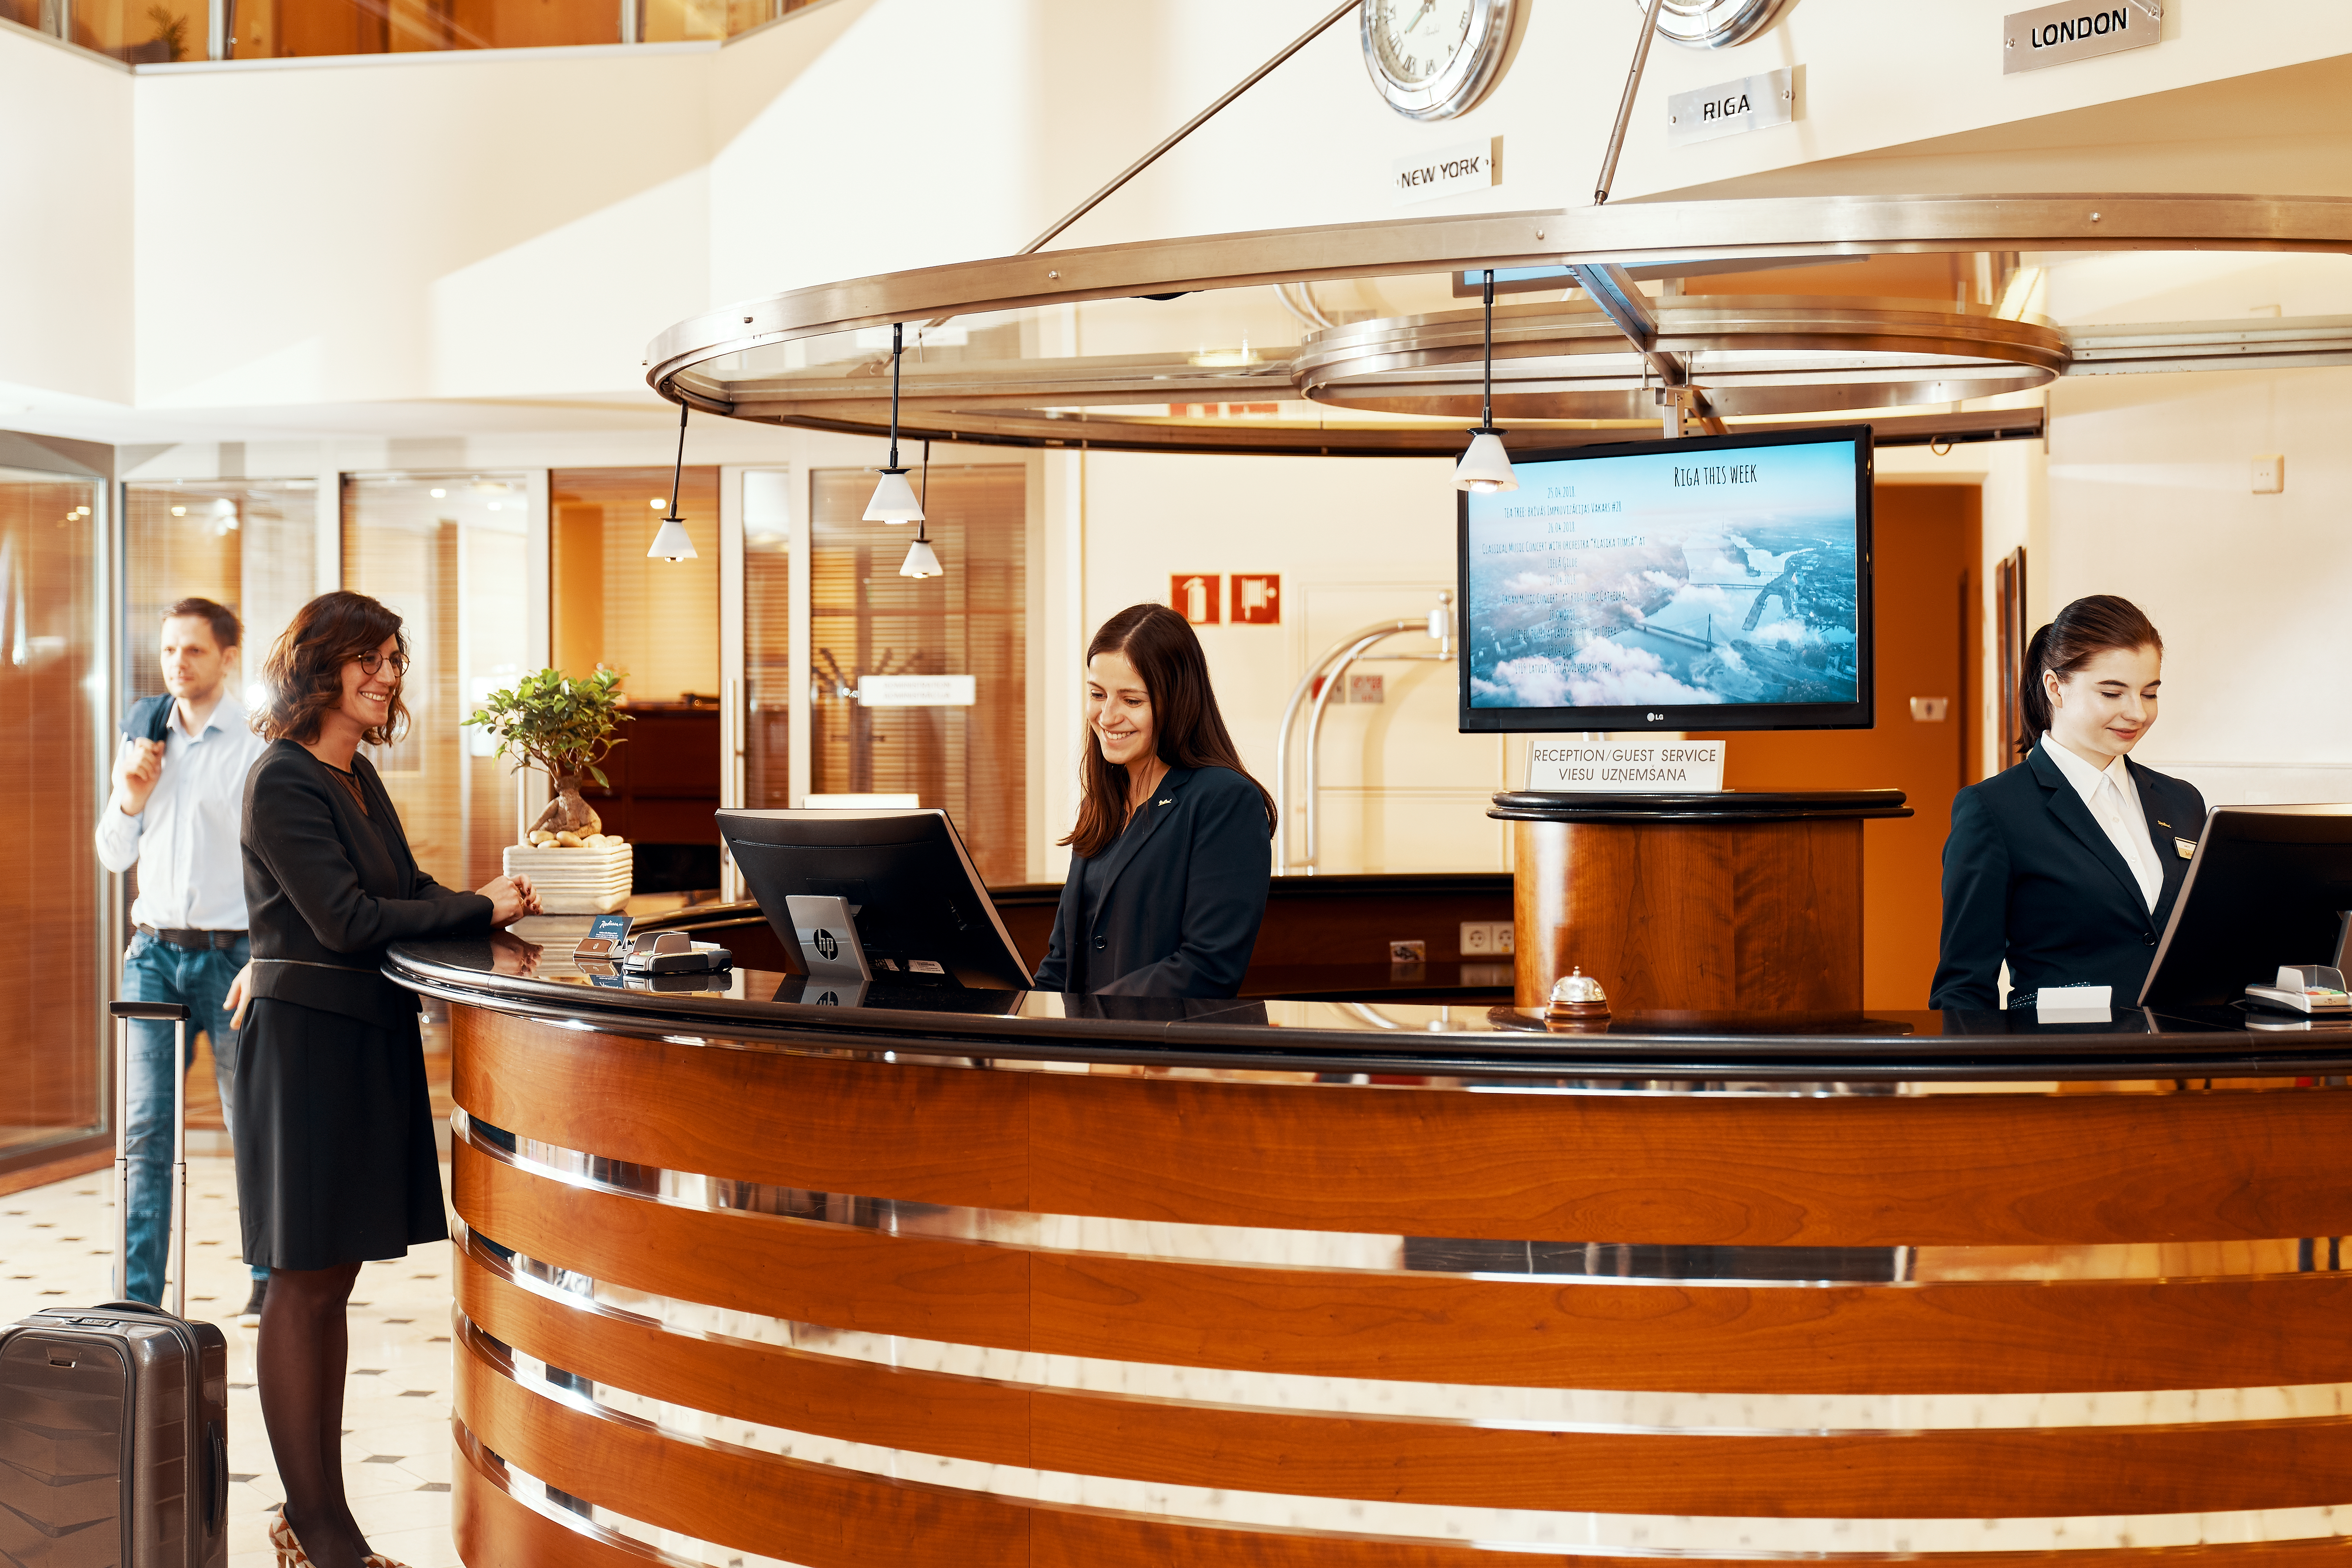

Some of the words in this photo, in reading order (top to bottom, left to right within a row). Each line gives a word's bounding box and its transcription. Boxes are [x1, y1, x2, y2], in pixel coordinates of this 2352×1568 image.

[2032, 7, 2129, 48] LONDON
[1703, 94, 1751, 122] RIGA
[1401, 166, 1435, 188] NEW
[1440, 156, 1479, 179] YORK
[1674, 467, 1700, 487] RIGA
[1703, 466, 1726, 485] THIS
[1730, 464, 1757, 484] WEEK
[1504, 507, 1513, 518] TEA
[1591, 502, 1610, 513] VAKARS
[1612, 501, 1621, 513] #28
[1482, 543, 1507, 554] CLASSICAL
[1509, 541, 1524, 553] MUSIC
[1526, 541, 1547, 552] CONCERT
[1548, 541, 1561, 550] WITH
[1562, 539, 1589, 550] ORCHESTRA
[1639, 536, 1645, 547] AT
[1519, 593, 1535, 605] MUSIC
[1561, 593, 1567, 603] AT
[1585, 590, 1598, 602] DOME
[1600, 589, 1628, 602] CATHEDRAL
[1510, 628, 1529, 640] GUIDED
[1554, 627, 1573, 638] LATVIA
[1601, 625, 1617, 637] OPERA
[1563, 661, 1597, 673] ANNIVERSARY
[1599, 661, 1612, 672] OPEN
[1534, 749, 1654, 762] RECEPTION/GUEST
[1661, 749, 1716, 762] SERVICE
[1559, 768, 1594, 781] VIESU
[1602, 764, 1687, 784] UZŅEMŠANA
[818, 928, 834, 960] hp
